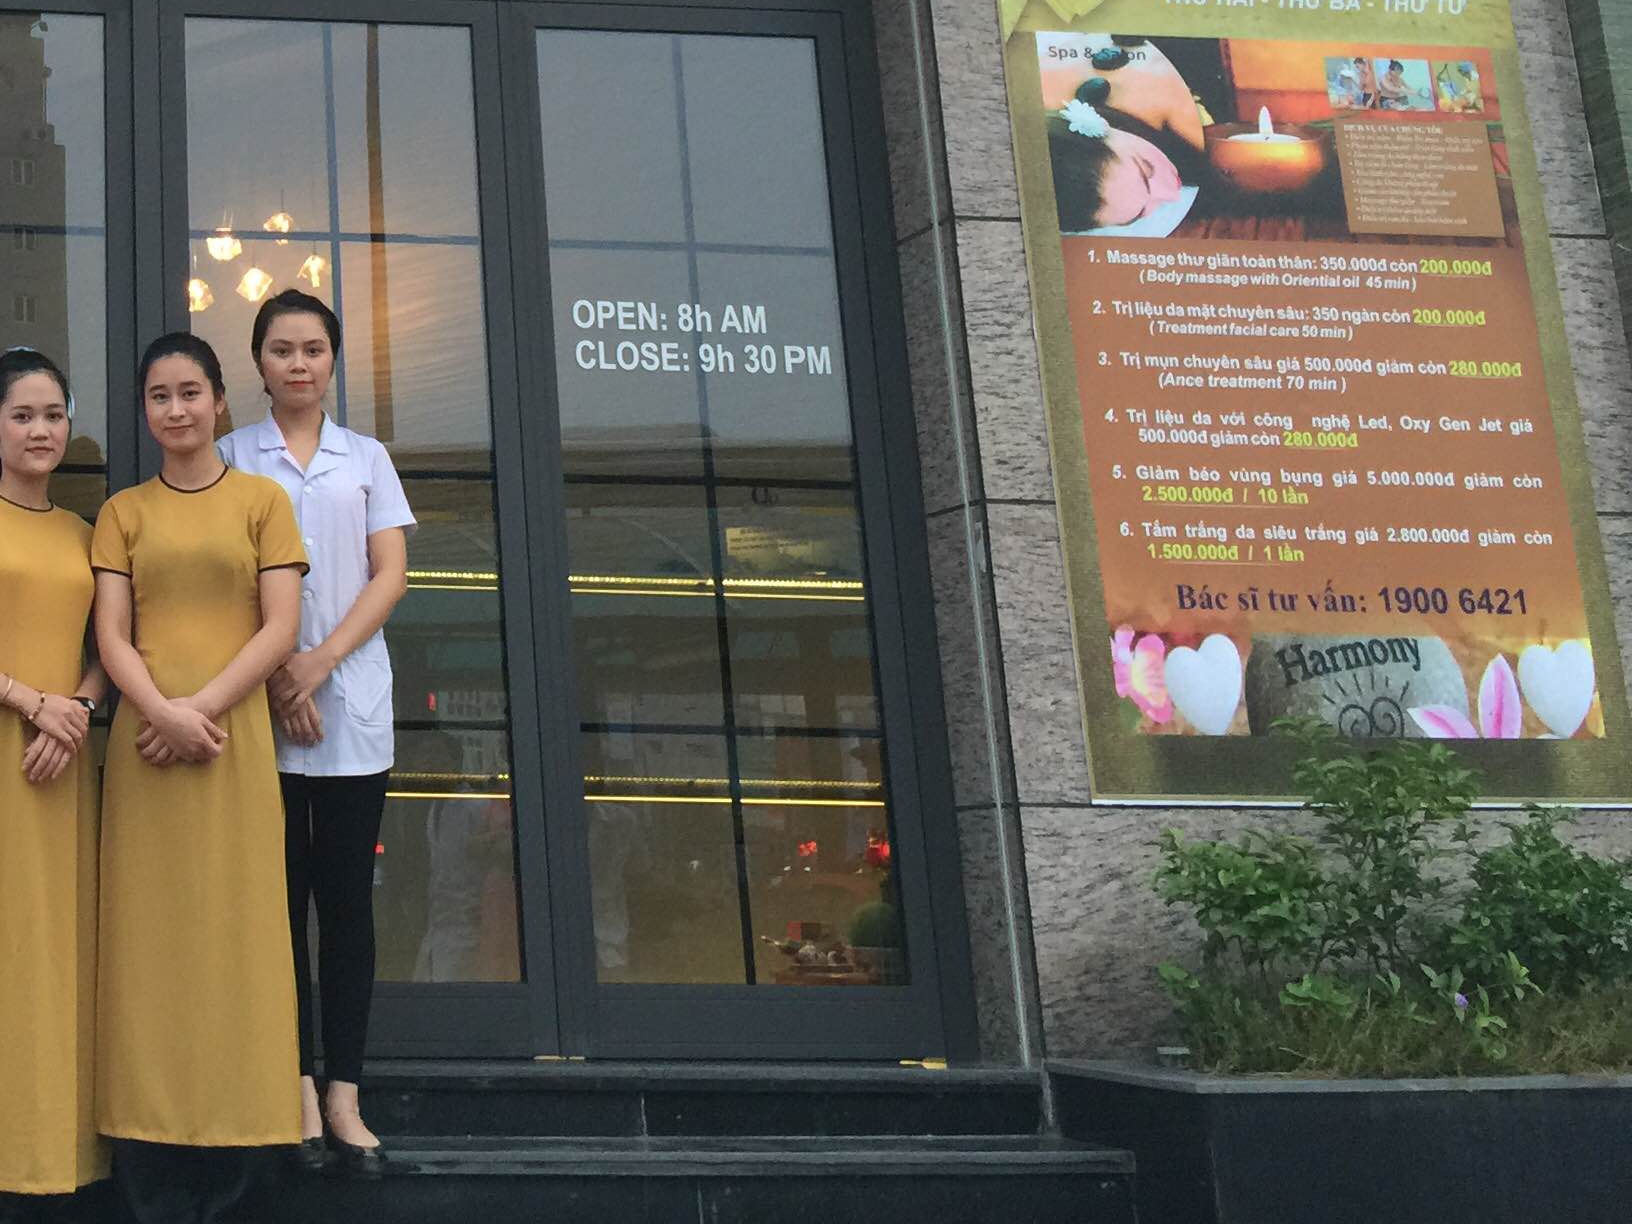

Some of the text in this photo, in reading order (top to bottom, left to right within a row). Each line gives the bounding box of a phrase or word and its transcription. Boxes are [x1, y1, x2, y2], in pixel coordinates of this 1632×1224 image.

[1048, 45, 1079, 61] Spa
[1084, 46, 1094, 60] &
[1088, 249, 1101, 264] 1.
[1106, 249, 1175, 267] Massage
[1207, 252, 1241, 271] giãn
[1242, 254, 1279, 268] toàn
[1390, 258, 1418, 273] còn
[1186, 273, 1248, 288] massage
[1250, 272, 1279, 286] with
[1342, 275, 1360, 288] oil
[1366, 276, 1382, 289] 45
[1384, 276, 1410, 290] min
[572, 299, 768, 334] OPEN: 8h AM
[1092, 299, 1106, 314] 2.
[1111, 300, 1133, 318] Trị
[1135, 301, 1163, 318] liệu
[1165, 302, 1185, 317] da
[1218, 304, 1275, 322] chuyên
[1312, 307, 1338, 322] 350
[1342, 308, 1380, 325] ngàn
[1382, 308, 1411, 323] còn
[1157, 320, 1347, 339] Treatment facial care 50 min
[575, 339, 832, 376] CLOSE: 9h 30 PM
[1098, 351, 1112, 366] 3.
[1119, 351, 1141, 369] Trị
[1145, 353, 1179, 370] mụn
[1183, 354, 1240, 371] chuyên
[1244, 355, 1272, 370] sâu
[1277, 356, 1300, 374] giá
[1418, 359, 1448, 375] còn
[1208, 374, 1282, 389] treatment
[1286, 376, 1304, 390] 70
[1308, 376, 1338, 391] min
[1104, 408, 1119, 423] 4.
[1126, 408, 1147, 426] Trị
[1155, 409, 1184, 426] liệu
[1192, 410, 1212, 425] da
[1219, 410, 1246, 426] với
[1253, 411, 1293, 430] công
[1312, 414, 1351, 432] nghệ
[1399, 415, 1431, 433] Oxy
[1439, 416, 1471, 432] Gen
[1478, 417, 1503, 433] Jet
[1509, 418, 1533, 436] giá
[1250, 431, 1281, 447] còn
[1112, 464, 1127, 480] 5.
[1189, 465, 1220, 482] béo
[1229, 467, 1271, 486] vùng
[1280, 468, 1323, 487] bụng
[1332, 469, 1358, 488] giá
[1512, 472, 1544, 489] còn
[1258, 488, 1278, 504] 10
[1119, 522, 1134, 538] 6.
[1235, 524, 1255, 540] da
[1263, 524, 1297, 540] siêu
[1354, 526, 1379, 545] giá
[1523, 528, 1553, 545] còn
[1176, 579, 1527, 616] Bác sĩ tư vấn: 1900 6421
[1273, 636, 1422, 687] Harmony
